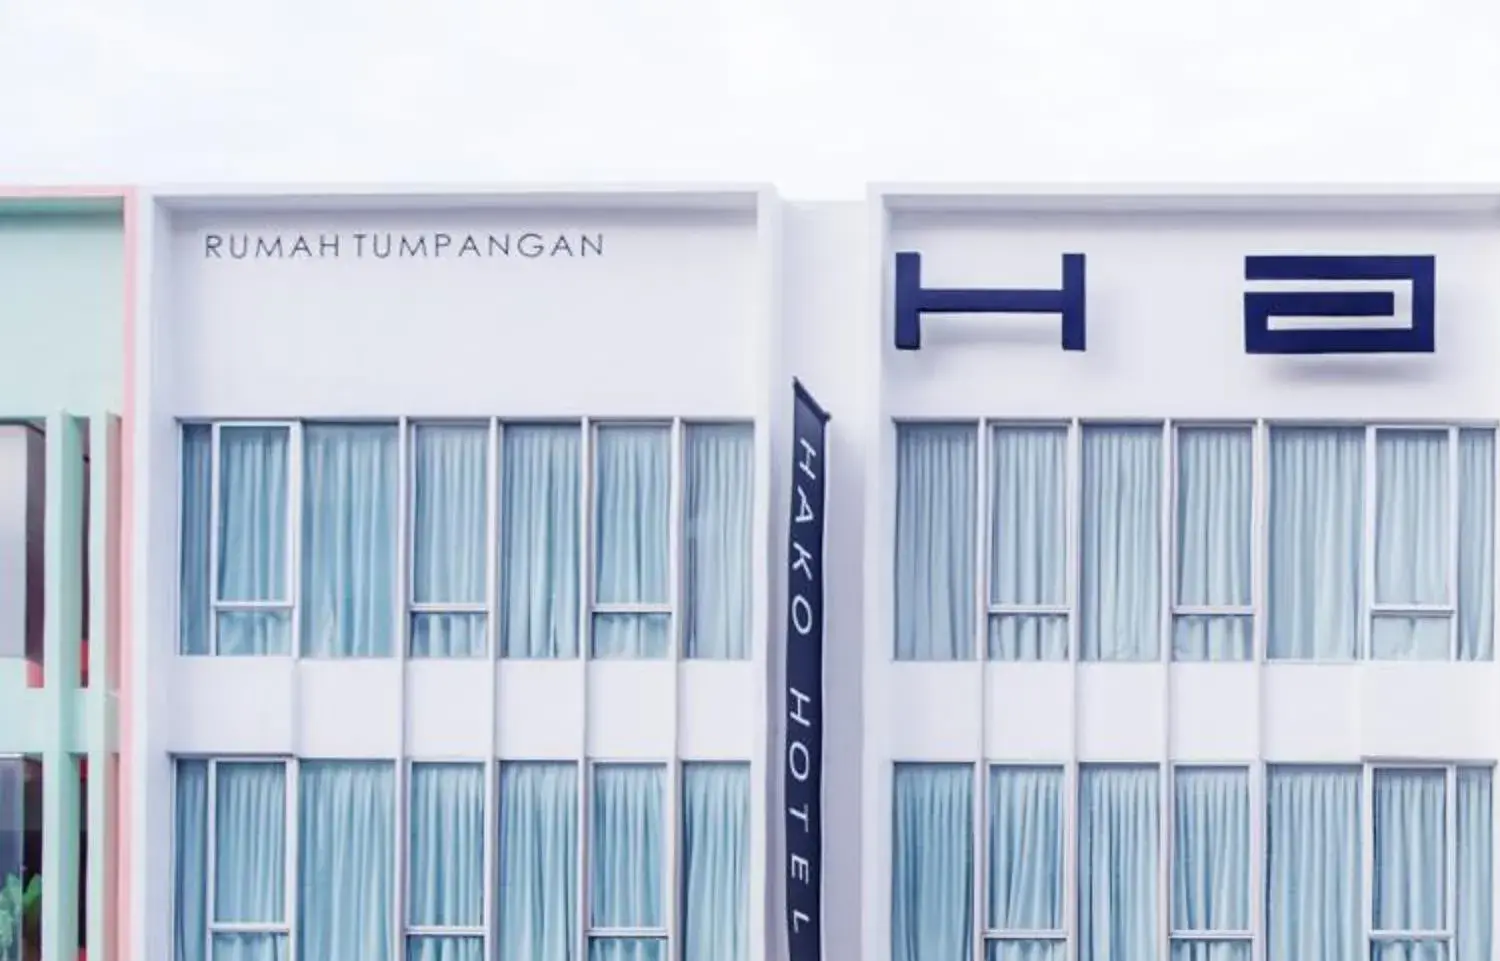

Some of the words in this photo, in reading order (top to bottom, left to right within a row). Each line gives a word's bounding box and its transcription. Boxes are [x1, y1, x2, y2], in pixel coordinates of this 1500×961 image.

[204, 232, 341, 260] RUMAH
[353, 232, 606, 259] TUMPANGAN
[790, 435, 817, 635] HAKO
[787, 686, 812, 941] HOTEL
